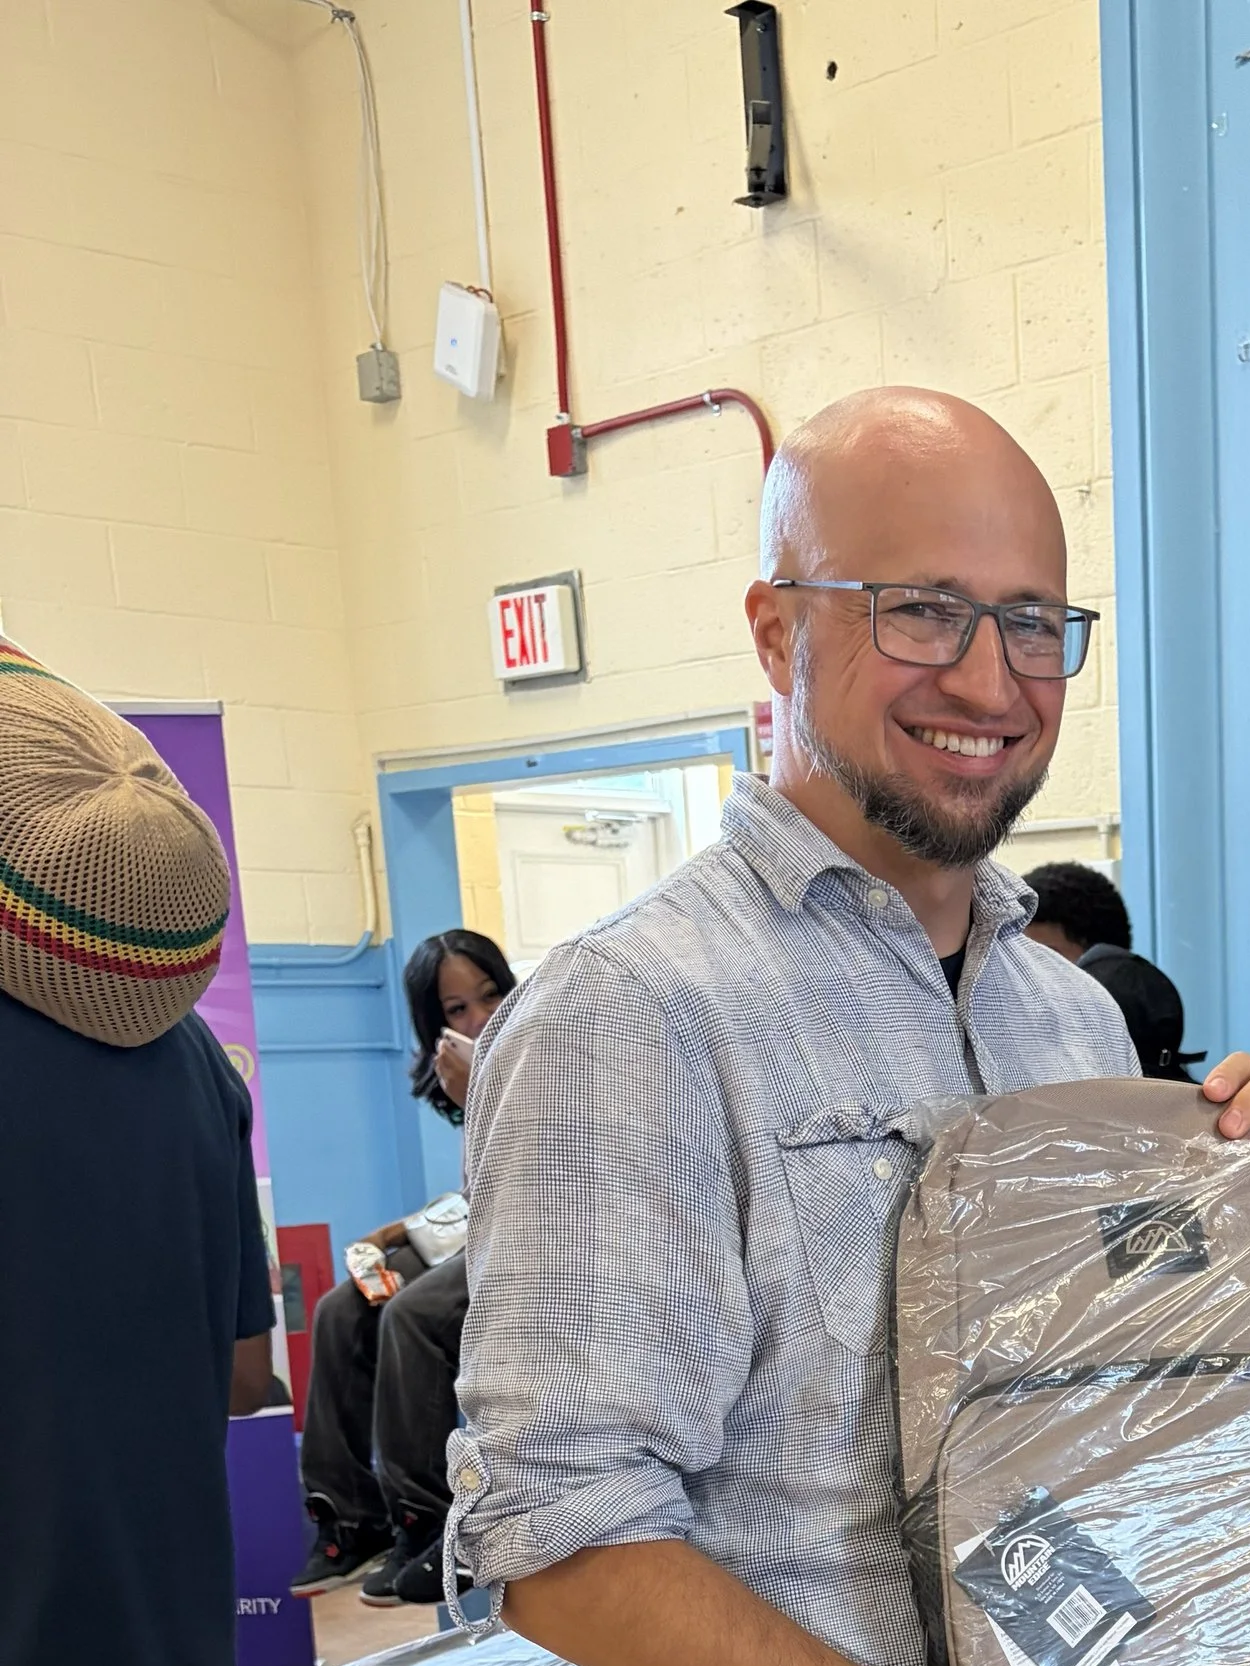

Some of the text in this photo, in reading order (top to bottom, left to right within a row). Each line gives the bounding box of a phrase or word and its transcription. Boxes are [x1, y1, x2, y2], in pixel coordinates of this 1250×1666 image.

[499, 593, 549, 668] EXIT
[1011, 1545, 1056, 1592] MOUNTAIN
[1027, 1560, 1052, 1587] EDGE
[236, 1597, 282, 1616] RITY
